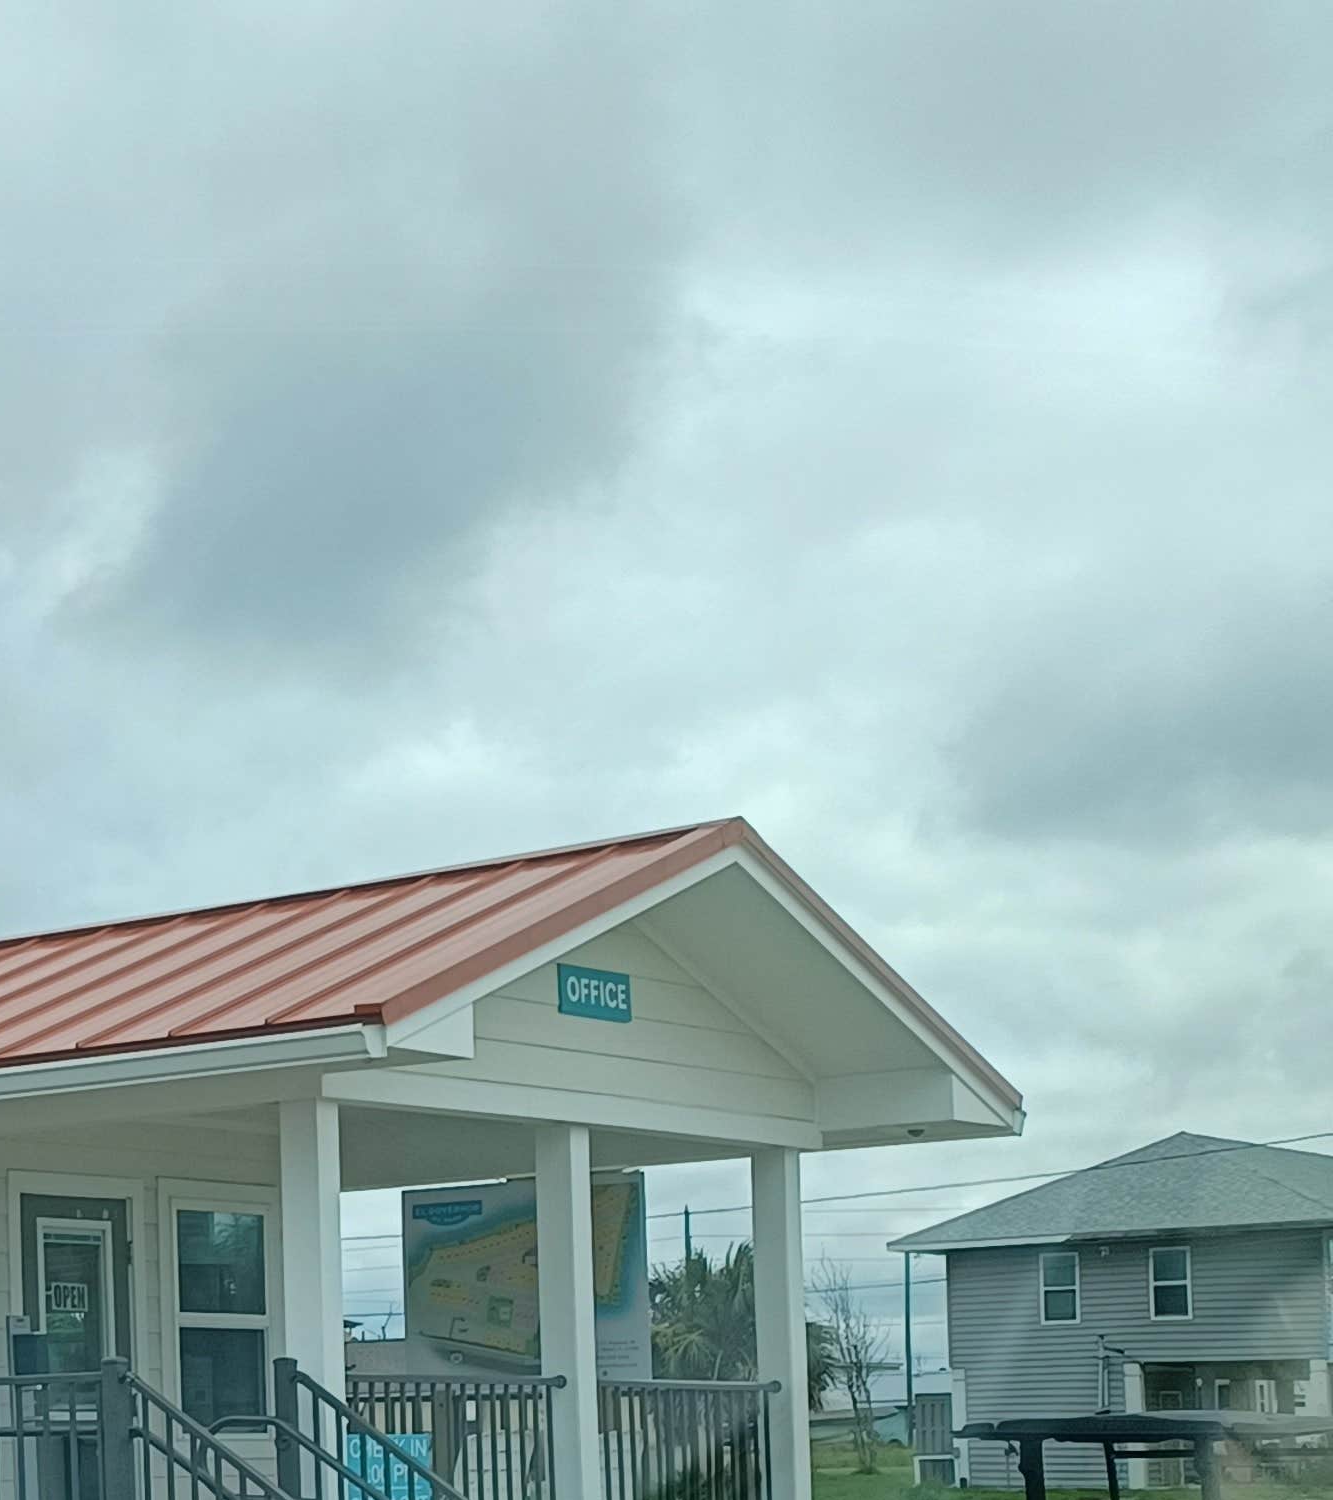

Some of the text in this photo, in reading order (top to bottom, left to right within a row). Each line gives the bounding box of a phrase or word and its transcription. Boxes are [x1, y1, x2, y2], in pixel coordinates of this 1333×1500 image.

[566, 976, 628, 1010] OFFICE
[53, 1284, 86, 1309] OPEN
[349, 1438, 428, 1458] CEK IN
